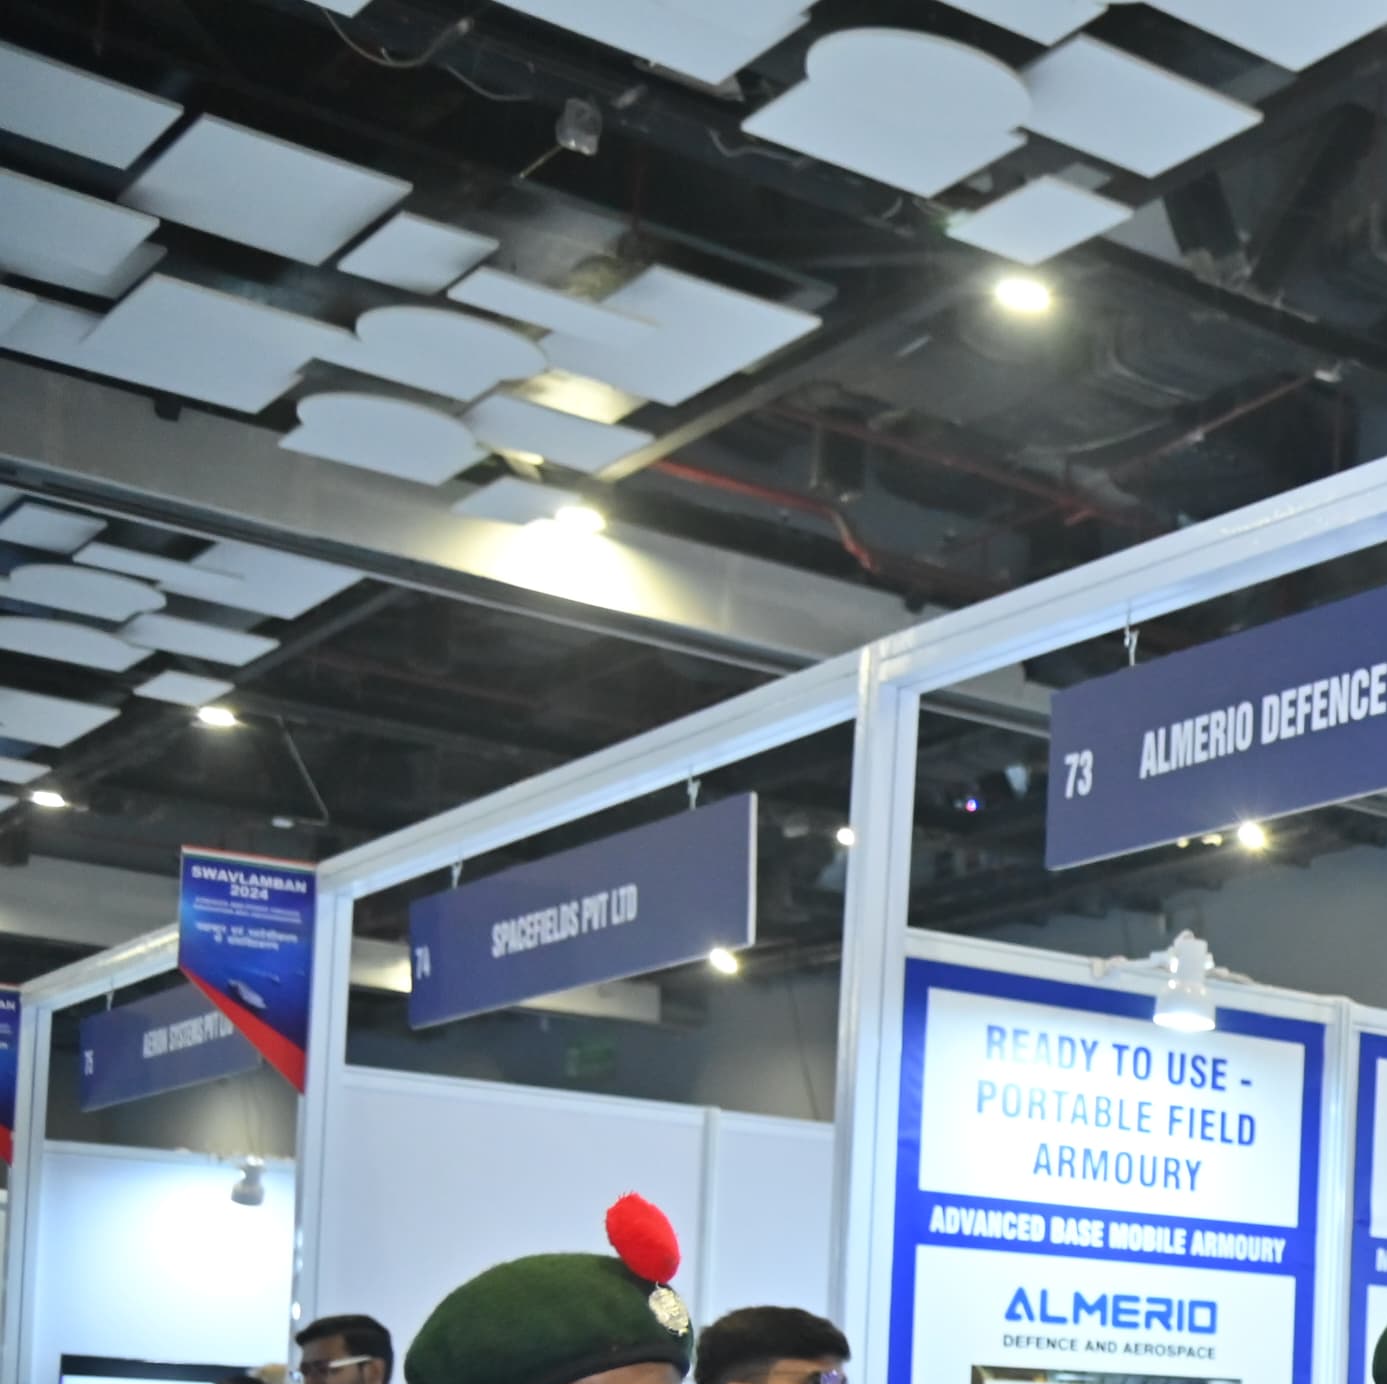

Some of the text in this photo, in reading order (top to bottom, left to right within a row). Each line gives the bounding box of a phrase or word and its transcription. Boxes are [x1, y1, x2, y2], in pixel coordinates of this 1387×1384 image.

[1064, 750, 1093, 798] 73
[1140, 702, 1253, 778] ALMERIO
[1261, 663, 1387, 746] DEFENCE
[191, 865, 307, 893] SWAVLAMBAN
[230, 884, 268, 900] 2024
[415, 883, 638, 980] 74 SPACEFIELDS PVT LTD
[985, 1024, 1098, 1072] READY
[1112, 1043, 1152, 1081] TO
[1167, 1052, 1228, 1092] USE
[976, 1080, 1256, 1146] PORTABLE FIELD
[1033, 1143, 1202, 1192] ARMOURY
[930, 1204, 1286, 1264] ADVANCED BASE MOBILE ARMOURY
[1004, 1286, 1216, 1334] ALMERIO
[1003, 1335, 1216, 1360] DEFENCE AND AEROSPACE
